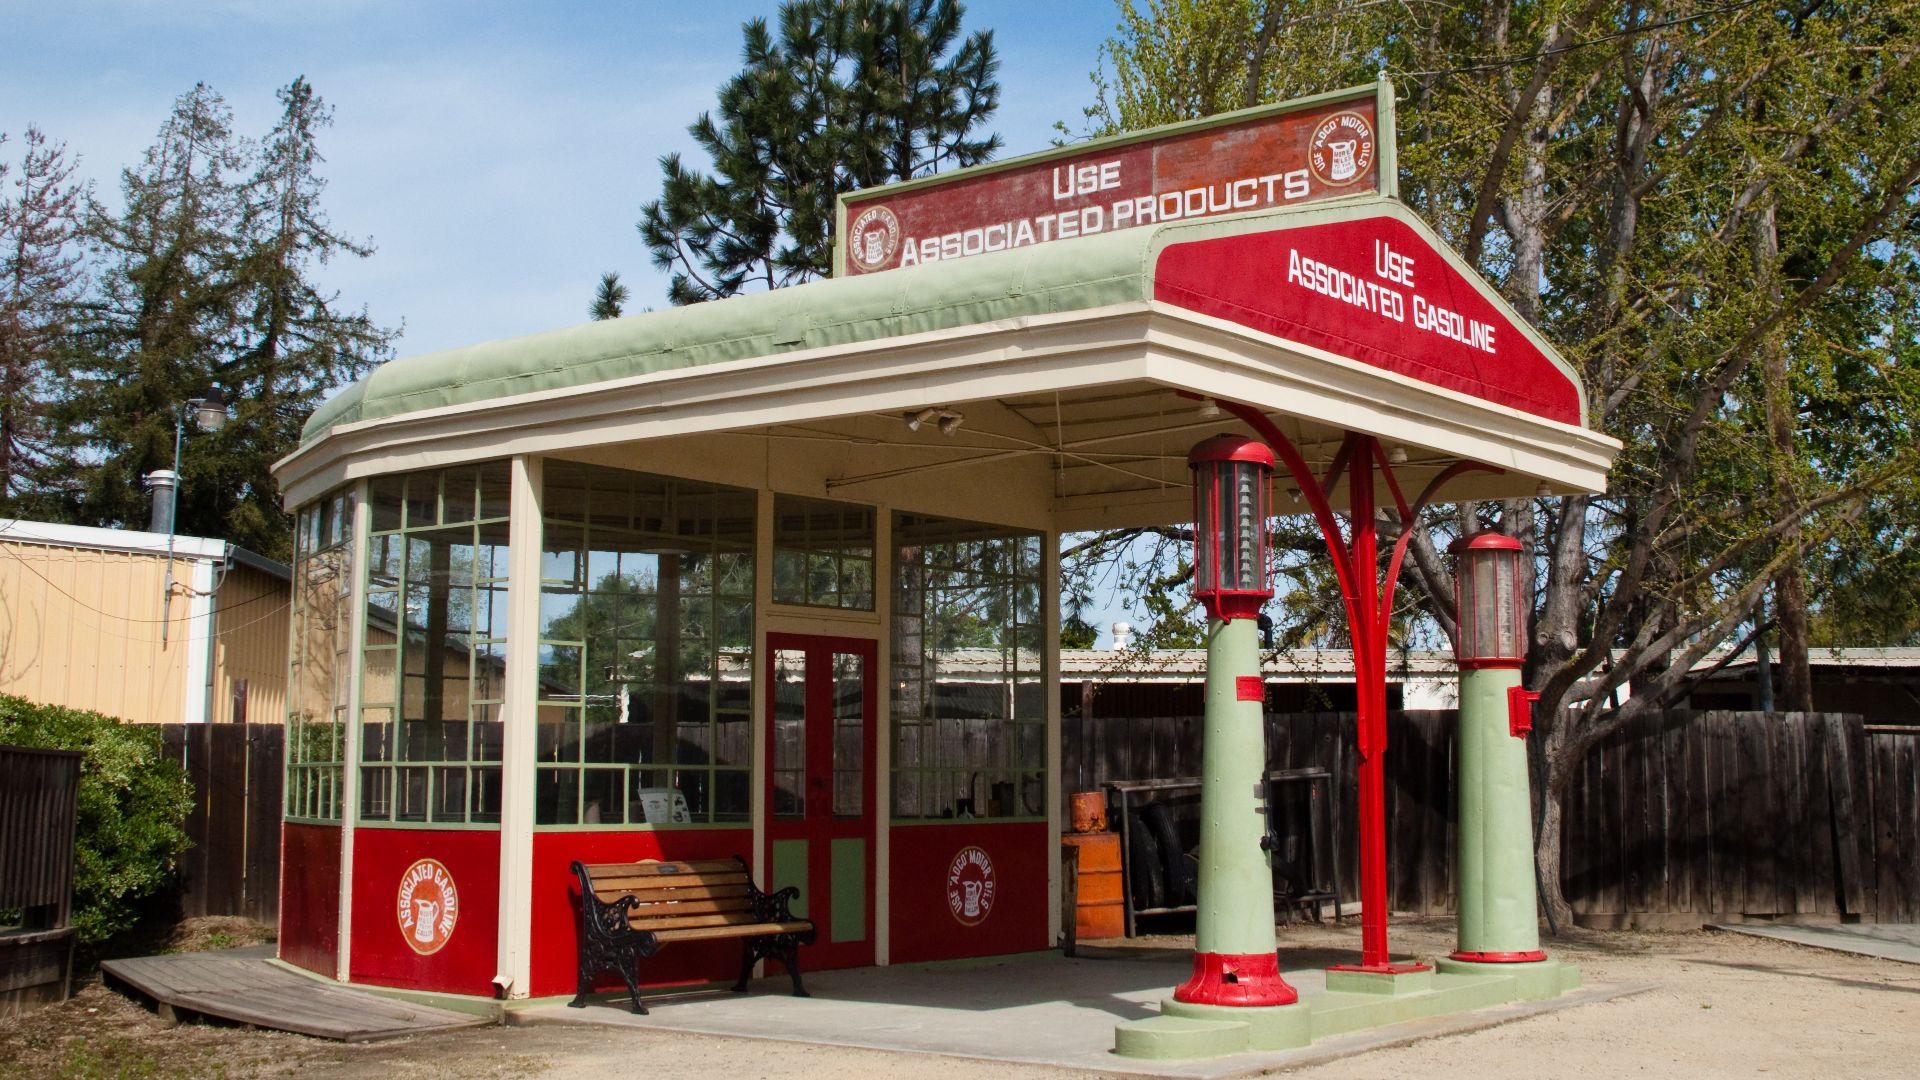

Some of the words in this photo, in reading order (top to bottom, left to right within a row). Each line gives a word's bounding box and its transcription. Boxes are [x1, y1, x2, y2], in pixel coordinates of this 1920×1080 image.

[1314, 152, 1326, 172] USE
[1341, 116, 1369, 139] MOTOR
[1357, 142, 1371, 167] OILS
[1053, 160, 1121, 200] USE
[853, 210, 877, 259] ASSOCIATED
[900, 206, 1104, 268] ASSOCIATED
[1112, 168, 1311, 229] PRODUCTS
[1375, 239, 1415, 288] USE
[1288, 248, 1405, 323] ASSOCIATED
[1413, 294, 1496, 354] GASOLINE
[400, 863, 433, 929] ASSOCIATED
[434, 868, 456, 937] GASOLINE
[950, 889, 963, 914] USE
[968, 849, 992, 879] MOTOR
[980, 880, 993, 910] OILS
